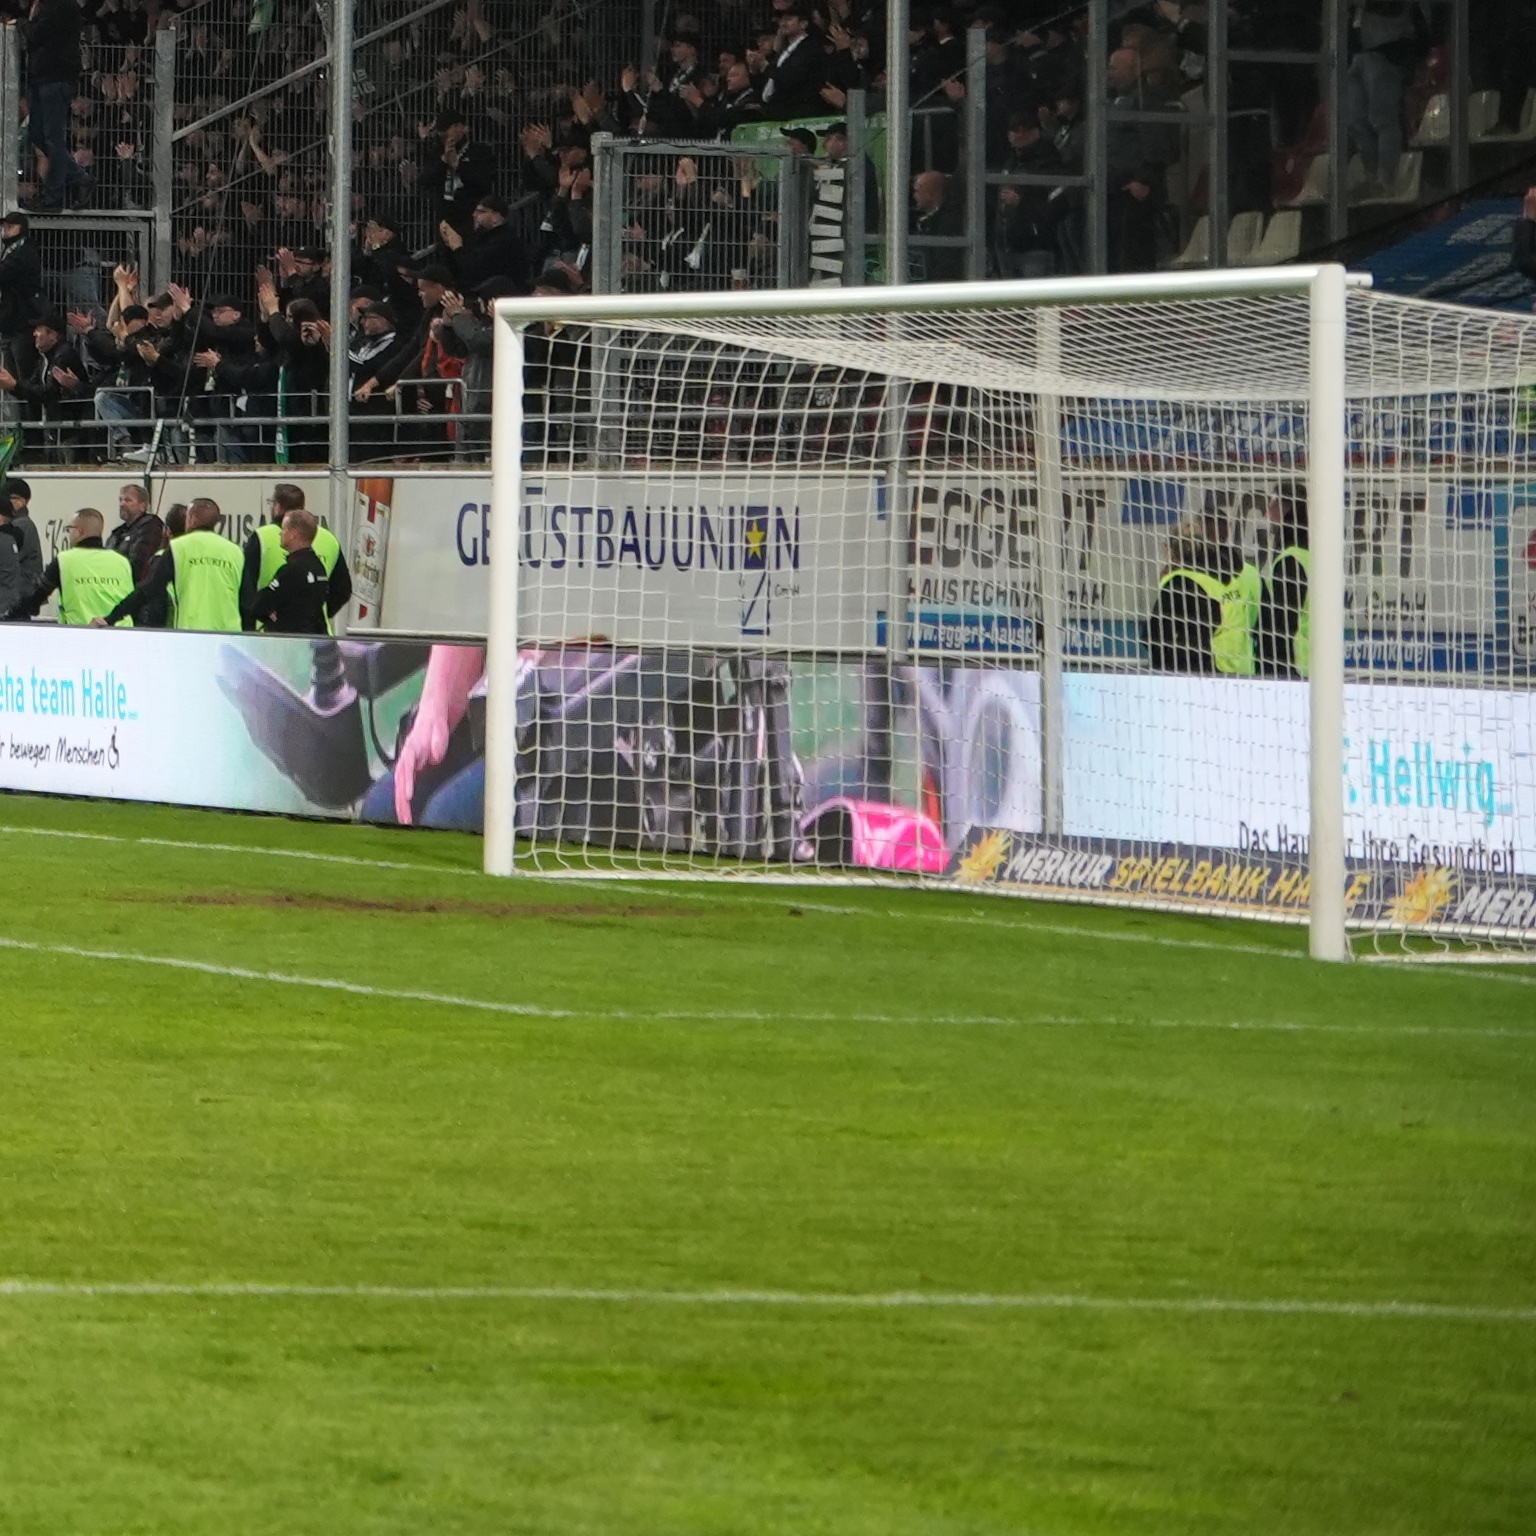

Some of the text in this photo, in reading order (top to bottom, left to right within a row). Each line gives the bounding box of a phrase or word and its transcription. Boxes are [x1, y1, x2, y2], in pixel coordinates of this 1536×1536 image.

[74, 576, 122, 588] SECURITY
[188, 557, 234, 570] SECURITY
[32, 666, 76, 717] team
[82, 668, 128, 720] Halle
[10, 732, 51, 769] bewegen
[55, 736, 106, 766] Menschen
[1369, 738, 1497, 829] Hellwig
[1239, 820, 1269, 853] Das
[1003, 846, 1113, 887] MERKUR
[1111, 855, 1271, 901] SPIELBANK
